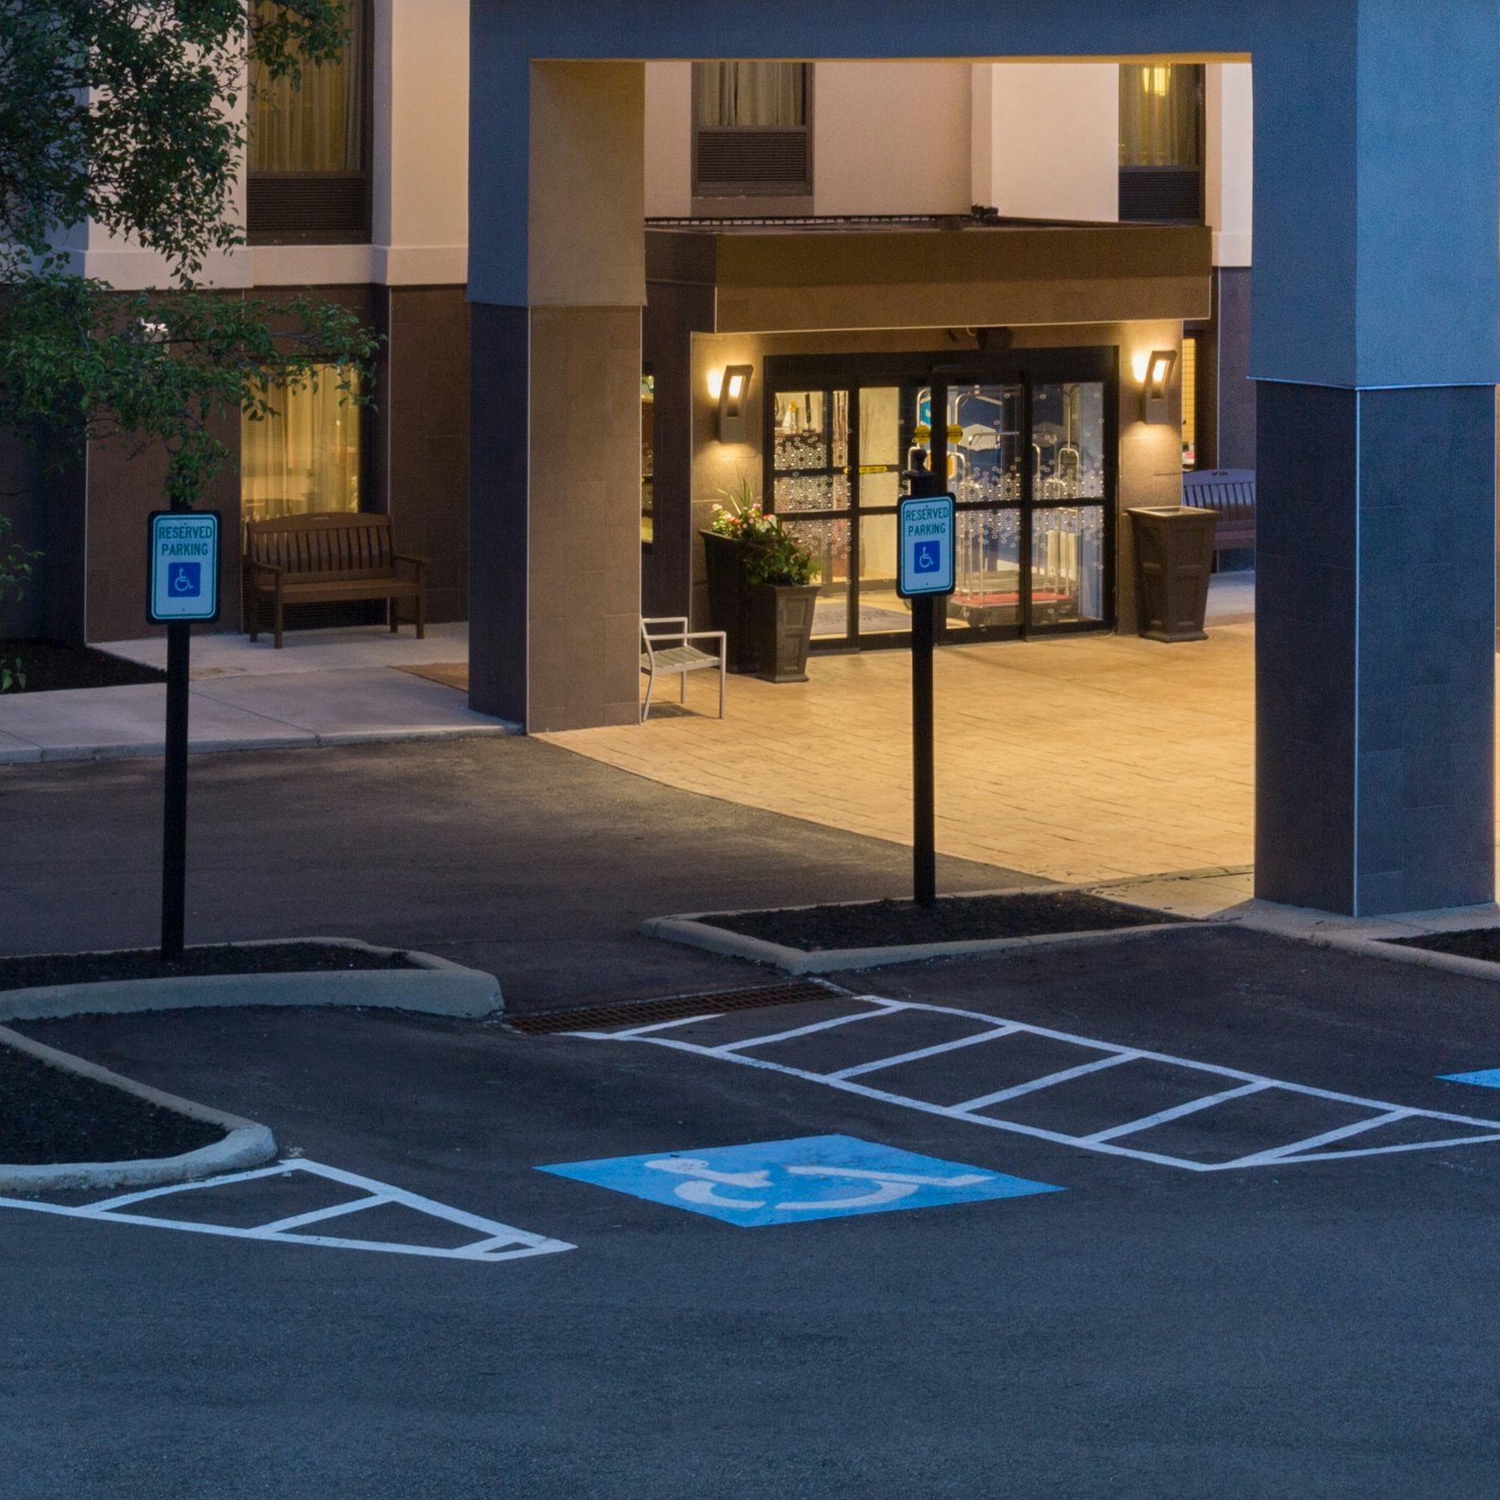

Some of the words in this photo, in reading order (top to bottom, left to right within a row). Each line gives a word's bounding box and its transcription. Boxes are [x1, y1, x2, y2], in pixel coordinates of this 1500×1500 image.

[905, 506, 949, 522] RESERVED
[158, 525, 213, 540] RESERVED
[907, 522, 946, 537] PARKING
[161, 542, 209, 557] PARKING
